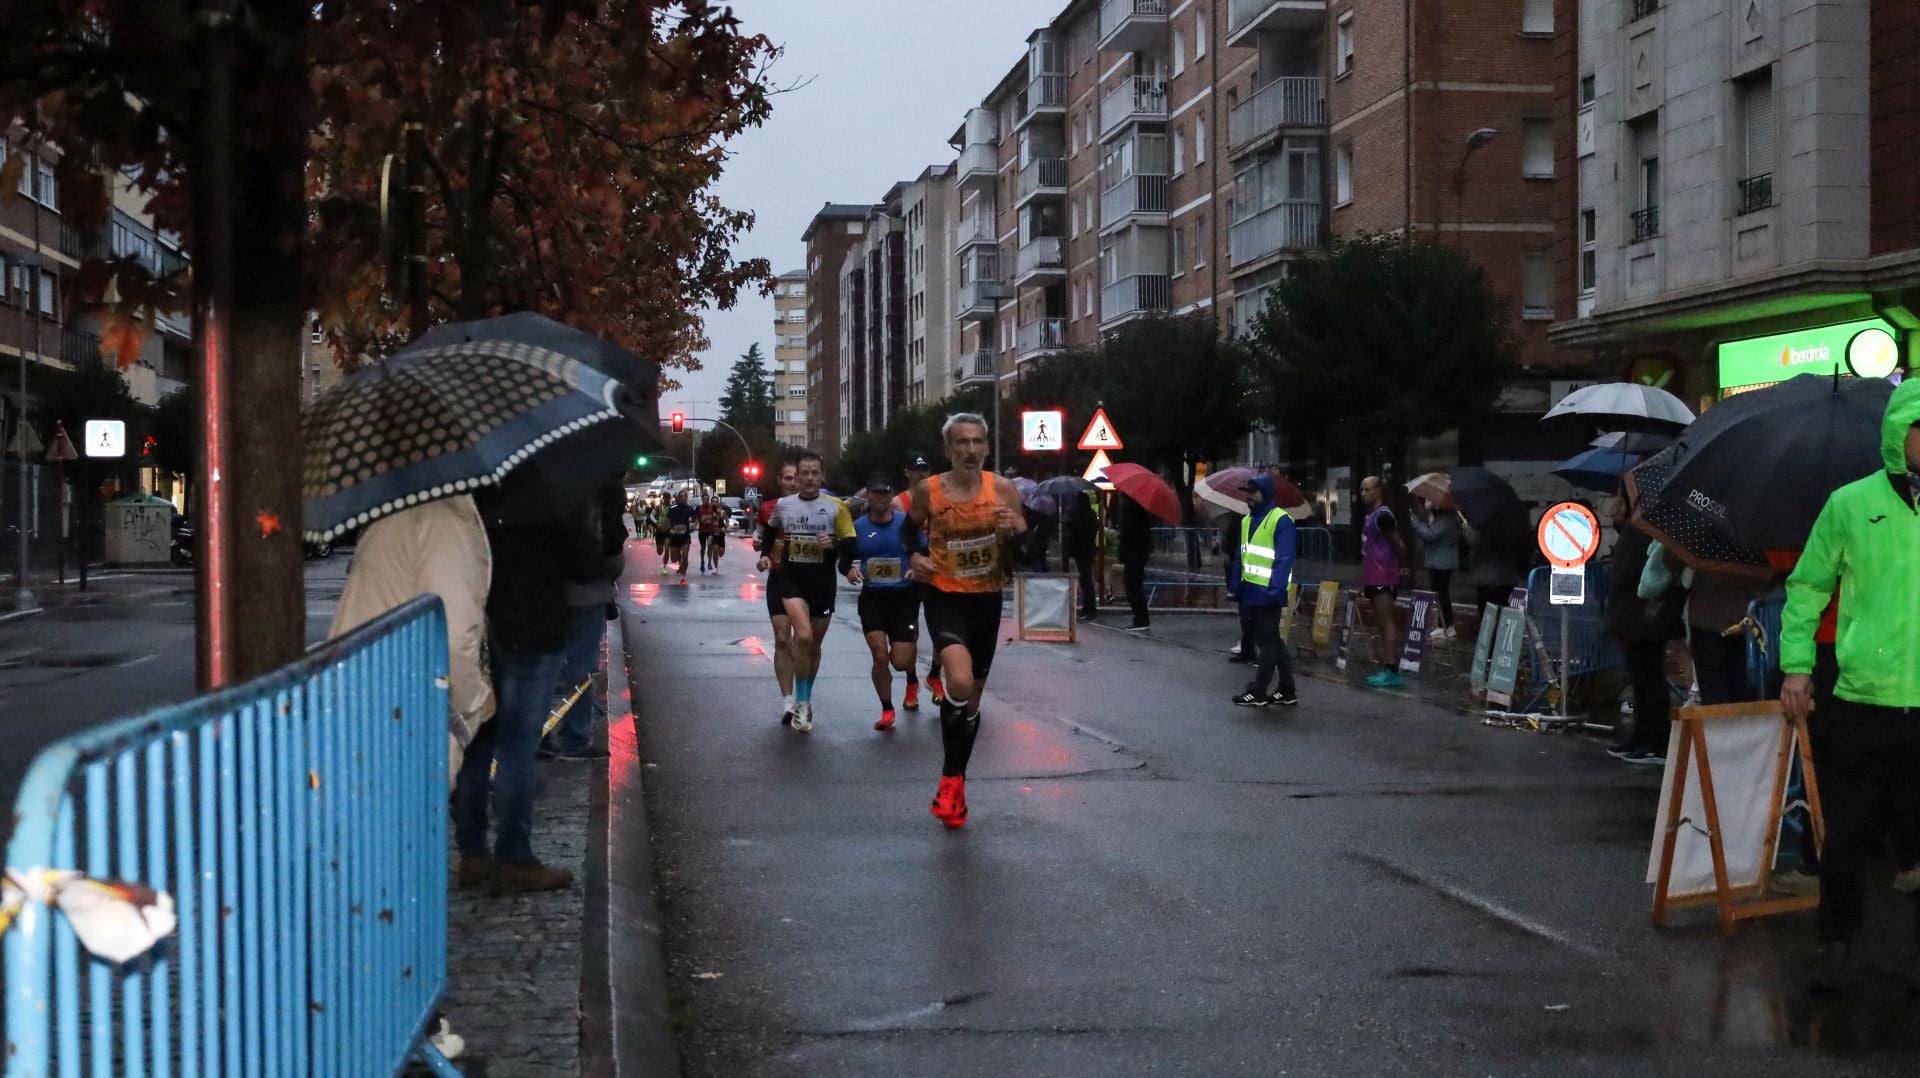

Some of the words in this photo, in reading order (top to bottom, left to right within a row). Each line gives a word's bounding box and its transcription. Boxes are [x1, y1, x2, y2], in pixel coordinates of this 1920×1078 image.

[1688, 488, 1727, 519] PROSOL
[955, 547, 993, 567] 365
[875, 565, 893, 577] 26
[1411, 600, 1429, 629] 14K
[1408, 630, 1421, 642] META
[1501, 618, 1518, 652] 7K
[1498, 654, 1512, 668] META
